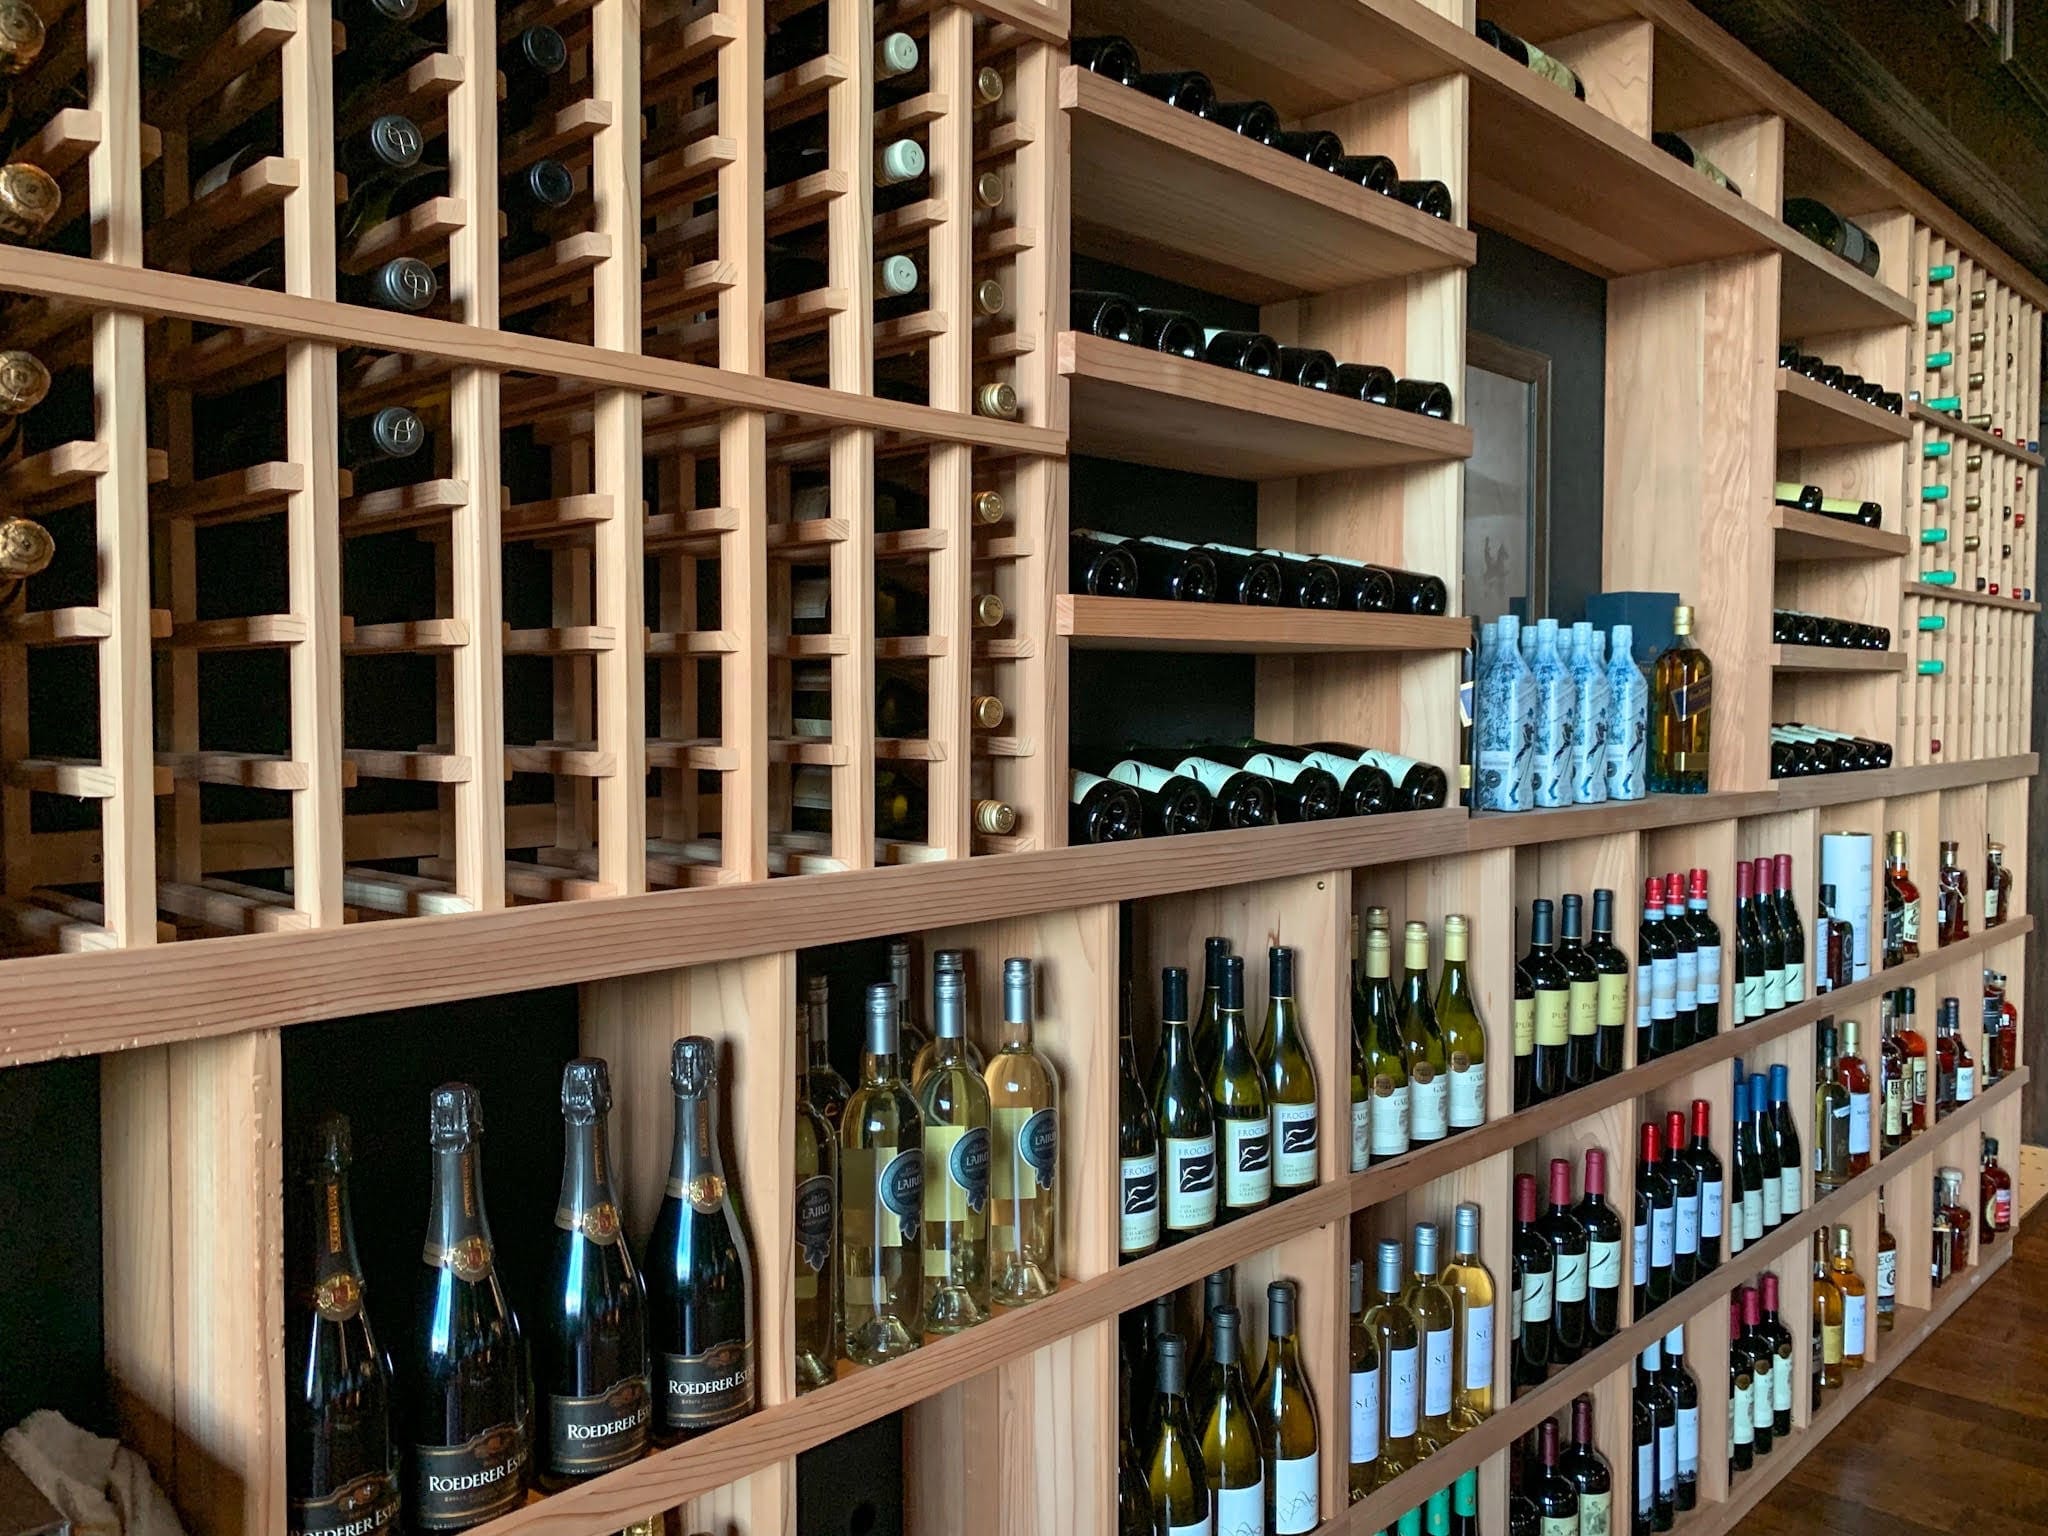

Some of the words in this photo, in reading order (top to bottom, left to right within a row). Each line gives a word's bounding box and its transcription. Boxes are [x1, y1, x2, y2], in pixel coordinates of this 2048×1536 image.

[803, 1203, 831, 1220] LAIRD
[669, 1376, 734, 1395] ROEDERER
[568, 1415, 636, 1439] ROEDERER
[430, 1465, 505, 1492] ROEDERER
